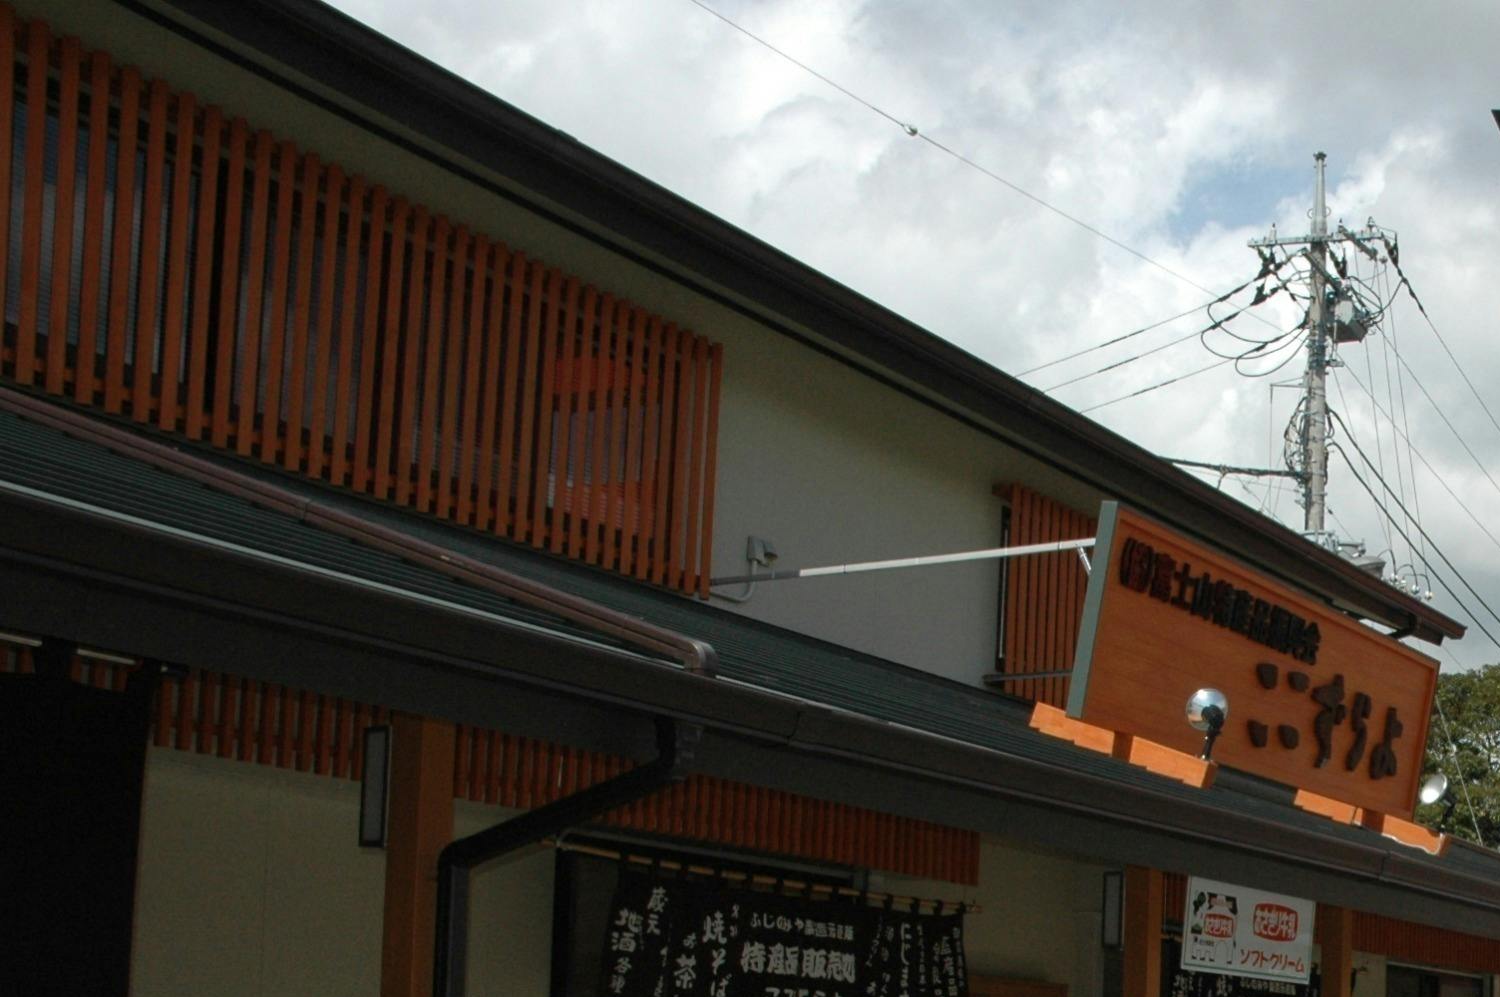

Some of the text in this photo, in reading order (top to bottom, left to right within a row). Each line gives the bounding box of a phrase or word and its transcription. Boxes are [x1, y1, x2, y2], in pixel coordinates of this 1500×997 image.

[1247, 662, 1403, 781] ここずらよ
[1240, 948, 1305, 974] ソフトクリーム
